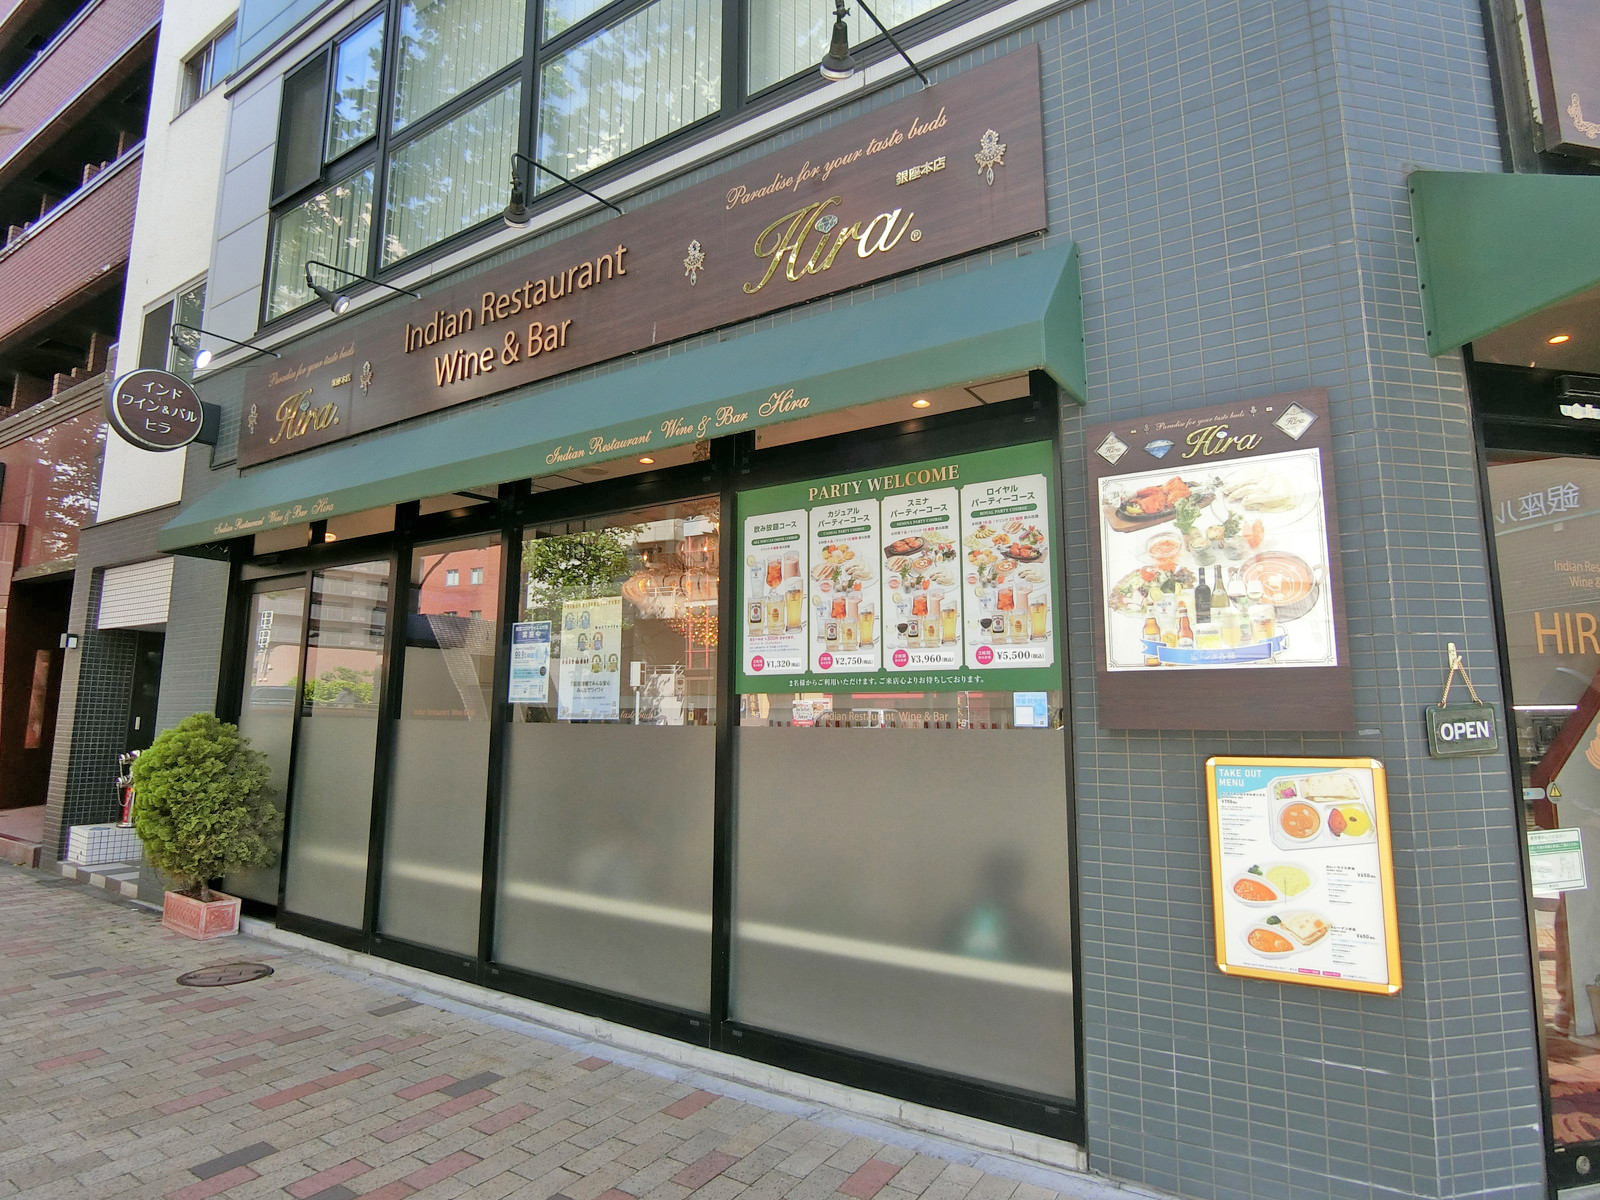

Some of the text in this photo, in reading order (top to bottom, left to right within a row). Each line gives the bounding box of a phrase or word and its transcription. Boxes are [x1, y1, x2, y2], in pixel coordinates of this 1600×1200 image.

[726, 106, 948, 210] Paradise for your taste buds
[895, 156, 947, 186] 銀座本店
[404, 243, 627, 353] Indian Restaurant
[435, 318, 573, 387] Wine & Bar
[142, 381, 183, 400] インド
[122, 393, 198, 423] ワイン&バル
[145, 418, 171, 434] ヒラ
[545, 388, 810, 465] Indian Restaurant Wine & Bar Hira
[1181, 424, 1263, 459] Hira
[808, 464, 960, 502] PARTY WELCOME
[986, 484, 1019, 496] ロイヤル
[908, 497, 930, 507] スミナ
[827, 507, 860, 518] カジュアル
[1554, 559, 1583, 572] Indian
[1569, 576, 1593, 588] Wine
[821, 711, 847, 722] dian
[849, 711, 895, 722] Restaunt
[898, 711, 922, 722] Wine
[924, 711, 931, 722] &
[933, 711, 949, 722] Bar
[1440, 721, 1490, 741] OPEN
[1219, 768, 1262, 778] TAKE OUT
[1218, 779, 1244, 787] MENU
